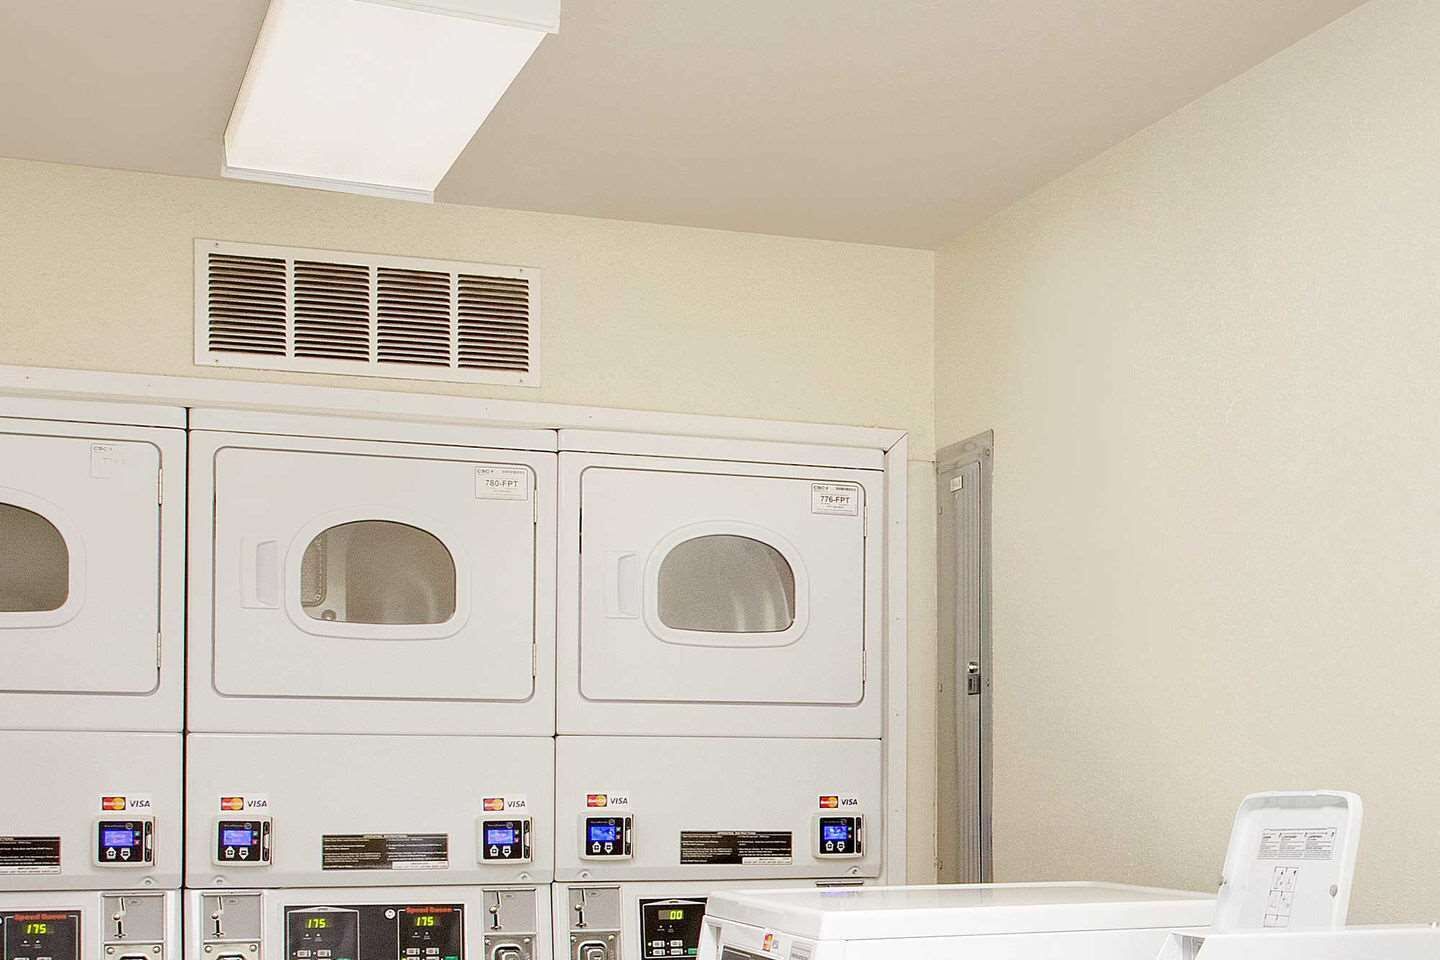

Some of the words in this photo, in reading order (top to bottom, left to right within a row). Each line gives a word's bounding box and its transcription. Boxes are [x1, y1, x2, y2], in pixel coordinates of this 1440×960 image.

[130, 800, 150, 808] VISA
[247, 800, 268, 808] VISA
[507, 800, 526, 808] VISA
[841, 798, 858, 806] VISA
